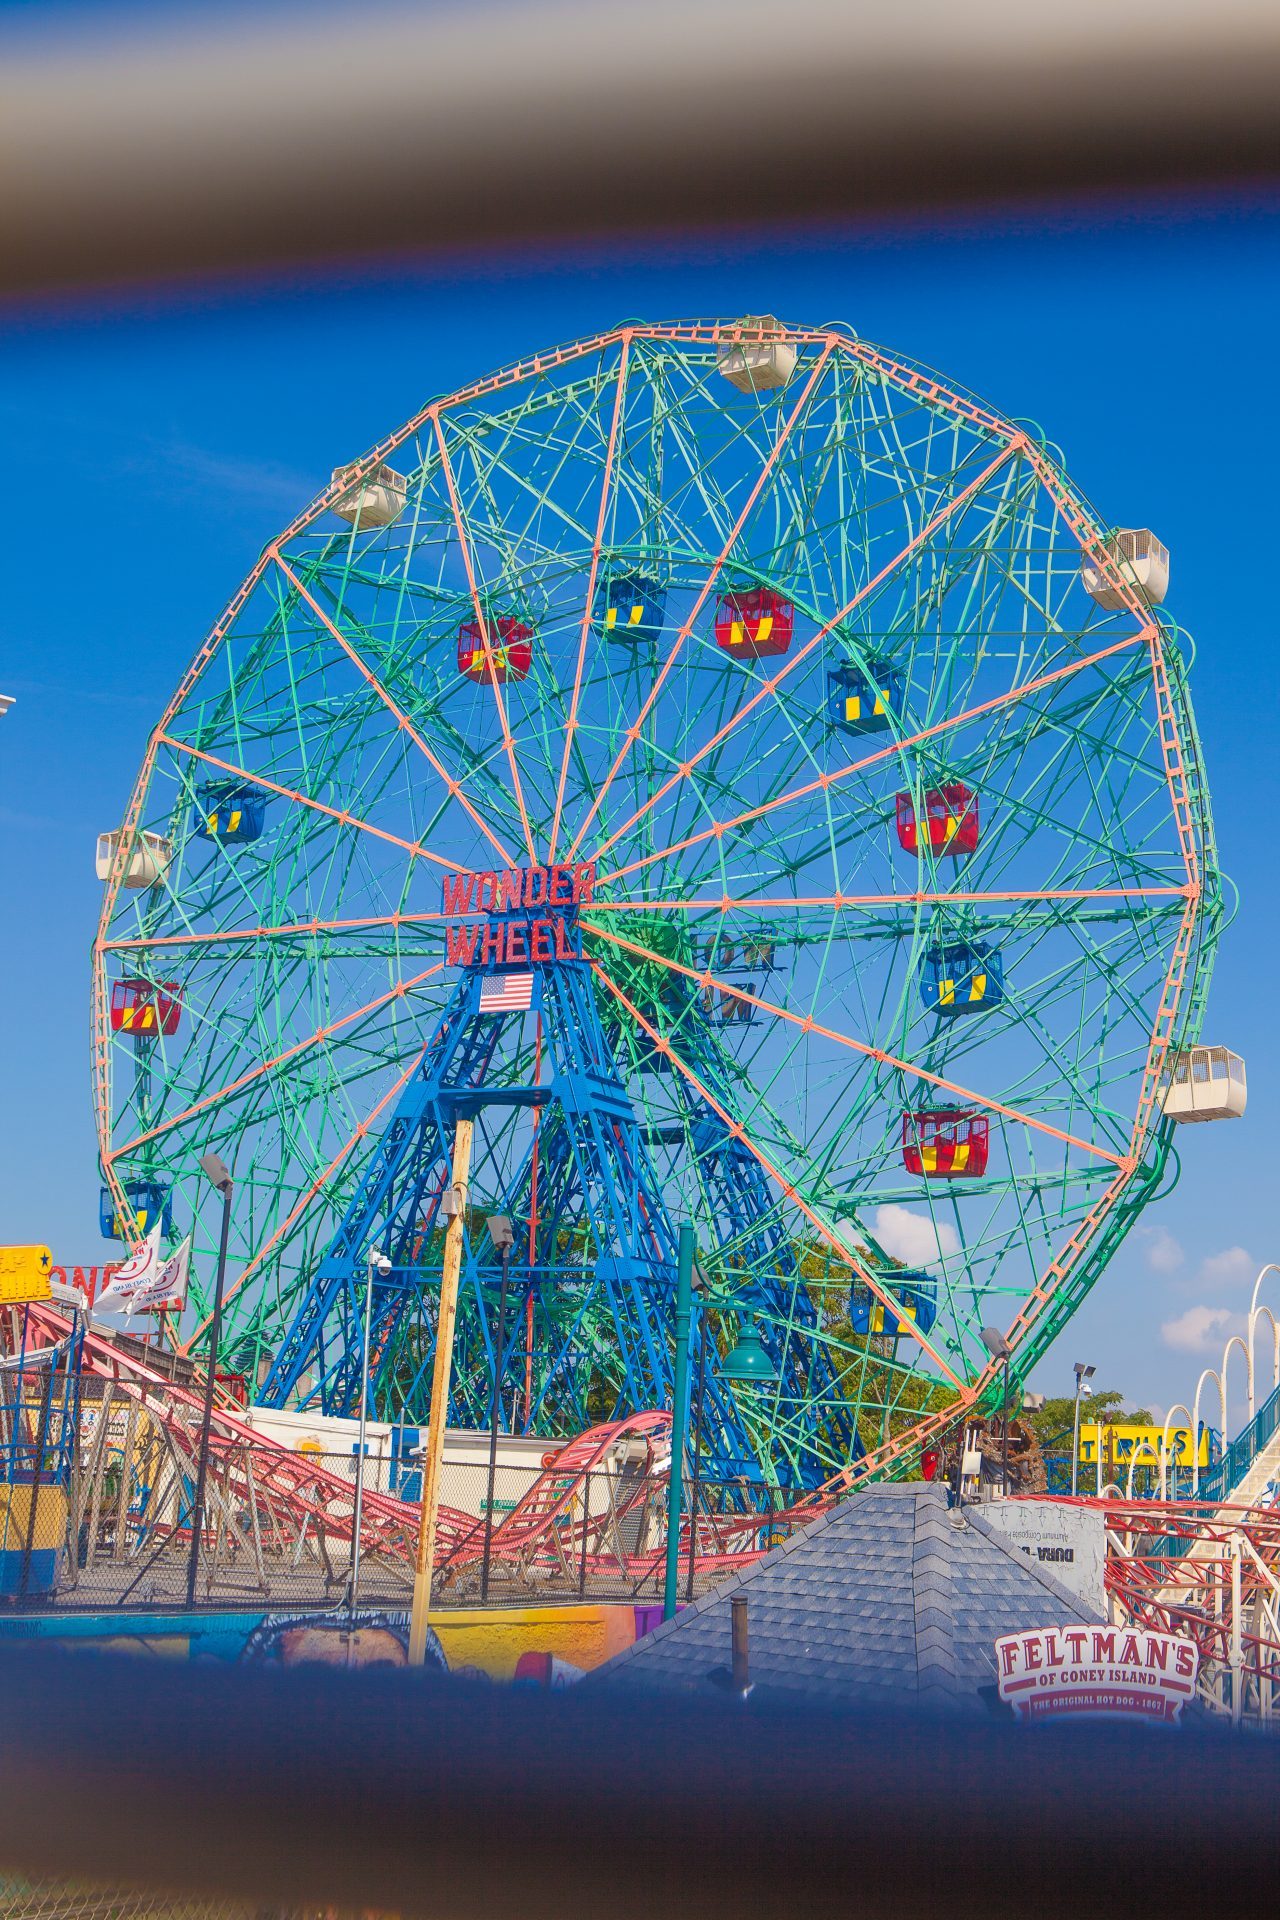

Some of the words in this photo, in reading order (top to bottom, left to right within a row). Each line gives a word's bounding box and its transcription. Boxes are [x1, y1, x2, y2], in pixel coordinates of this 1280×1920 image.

[443, 863, 595, 914] WONDER
[446, 917, 577, 966] WHEEL
[1000, 1632, 1195, 1677] FELTMAN'S
[1039, 1673, 1057, 1686] OF
[1060, 1670, 1105, 1683] CONEY
[1108, 1670, 1157, 1686] ISLAND
[1033, 1700, 1051, 1710] THE
[1052, 1695, 1095, 1706] ORIGINAL
[1096, 1695, 1114, 1705] HOT
[1116, 1696, 1135, 1706] DOG
